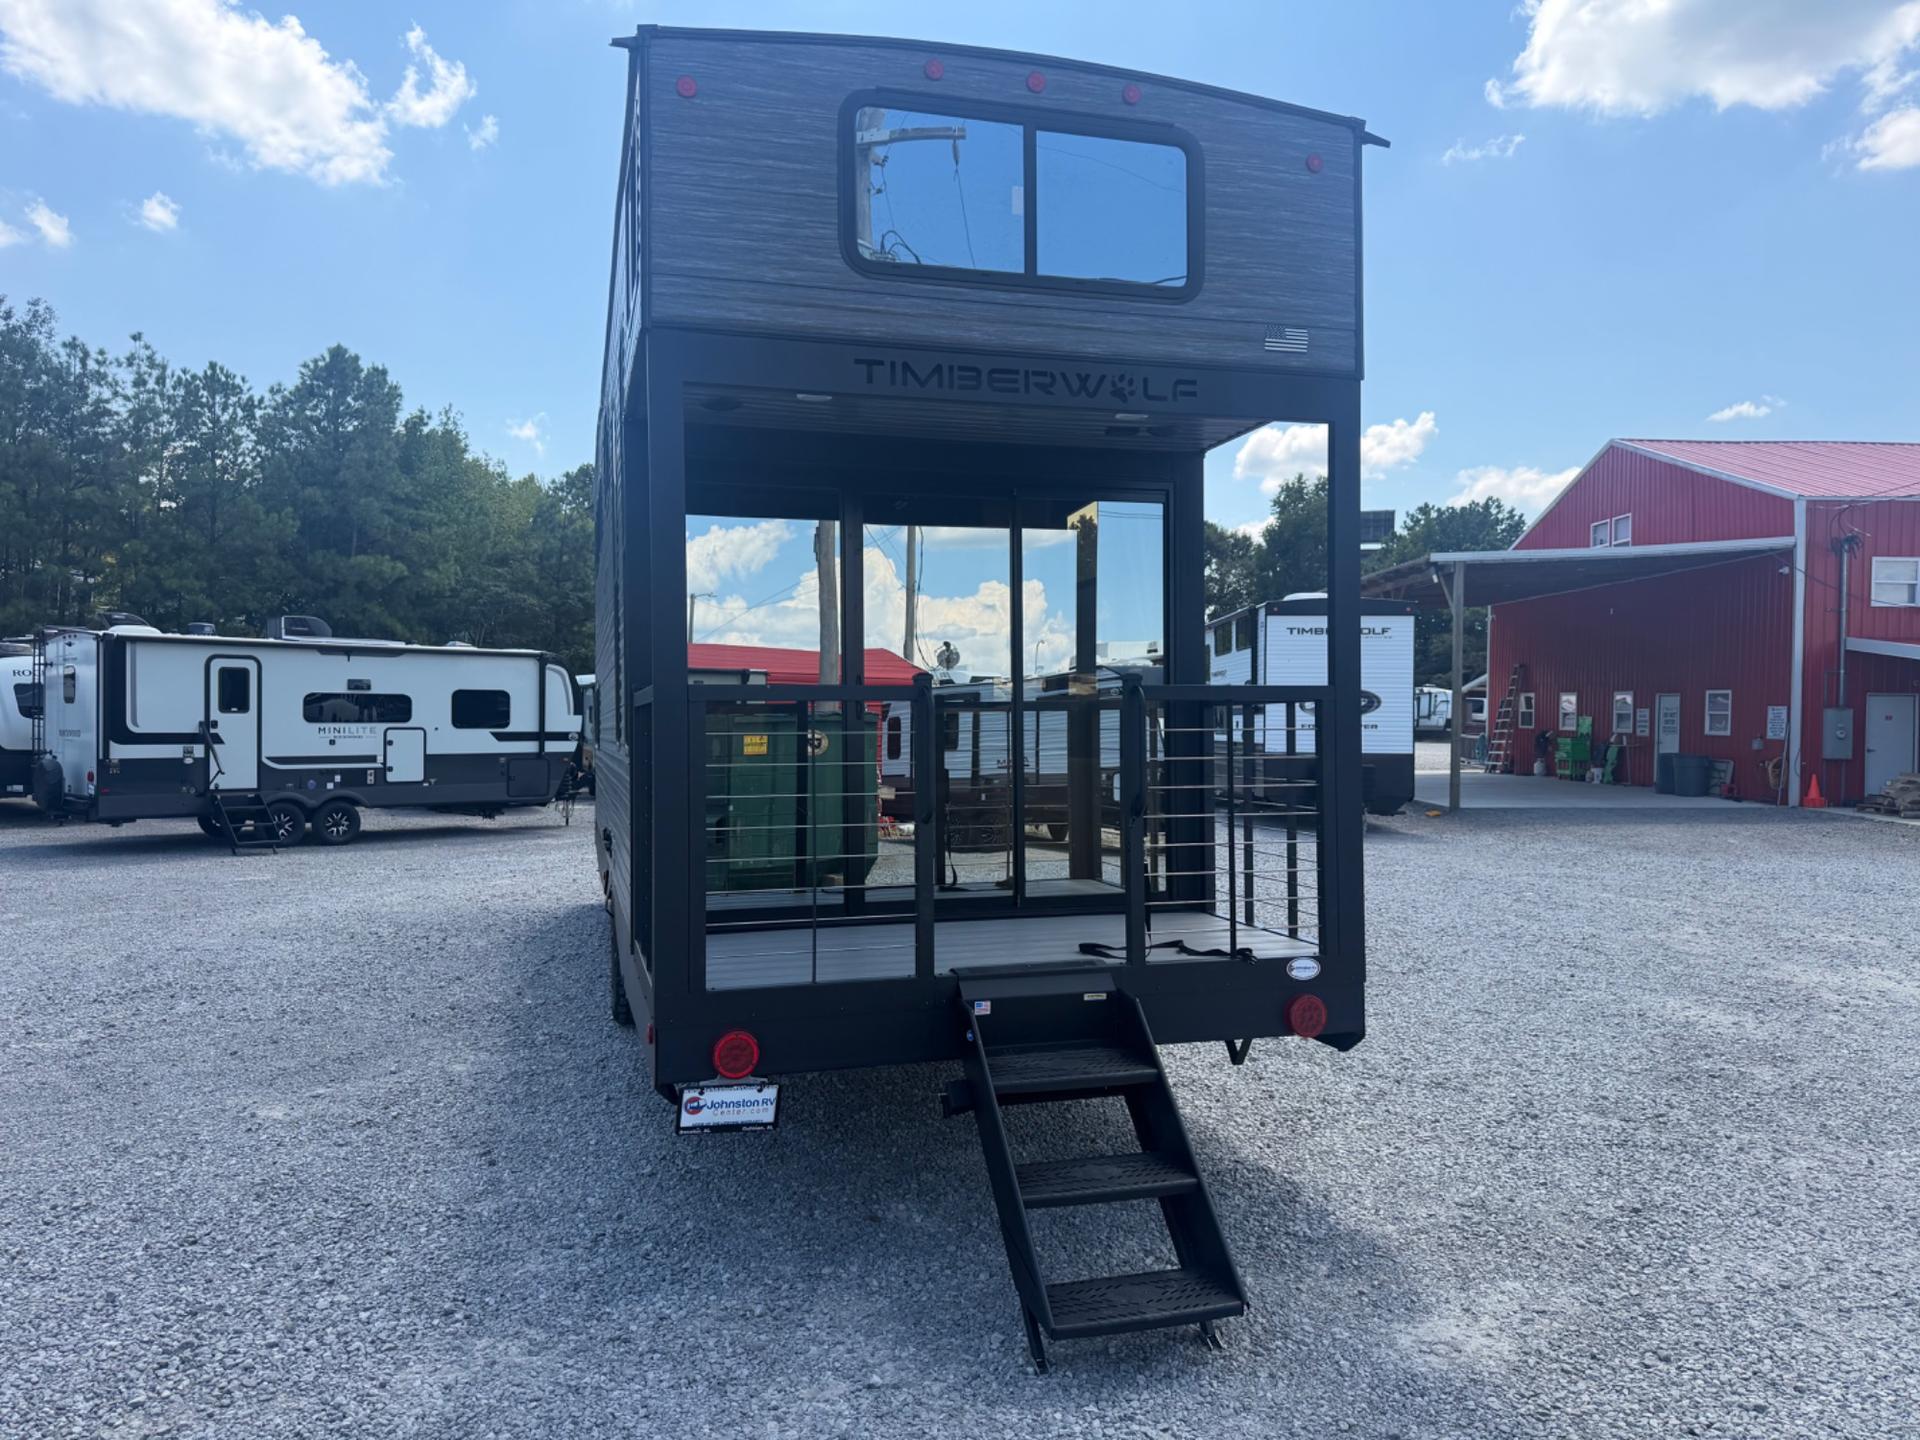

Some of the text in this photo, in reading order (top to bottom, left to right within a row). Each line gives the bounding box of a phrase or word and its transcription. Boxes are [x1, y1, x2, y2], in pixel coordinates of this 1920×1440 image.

[1286, 627, 1391, 635] TIMBOLF
[317, 726, 377, 735] MINILITE
[706, 1097, 776, 1109] Johnston RV
